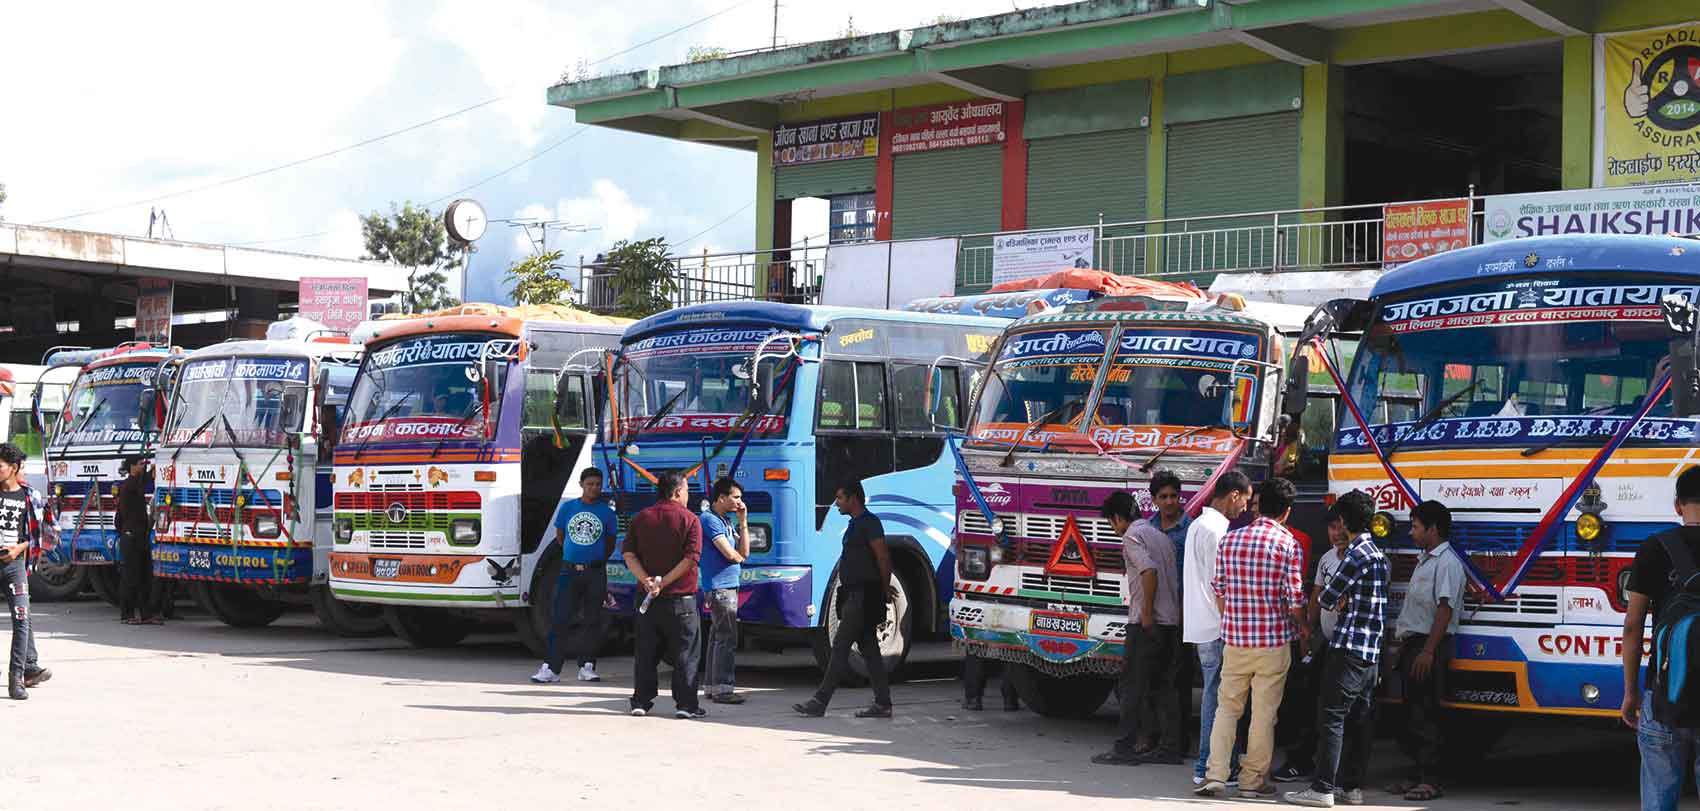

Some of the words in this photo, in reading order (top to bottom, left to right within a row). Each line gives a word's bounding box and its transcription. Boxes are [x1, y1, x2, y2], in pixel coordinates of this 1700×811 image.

[1641, 30, 1700, 60] ROADL
[1666, 103, 1695, 115] 2014
[863, 118, 877, 136] घर
[1383, 290, 1519, 321] जलजला
[1122, 336, 1245, 355] यातायात
[1455, 420, 1521, 439] LED
[83, 465, 99, 473] TATA
[197, 470, 216, 480] TATA
[152, 549, 180, 561] SPEED
[215, 554, 269, 568] CONTROL
